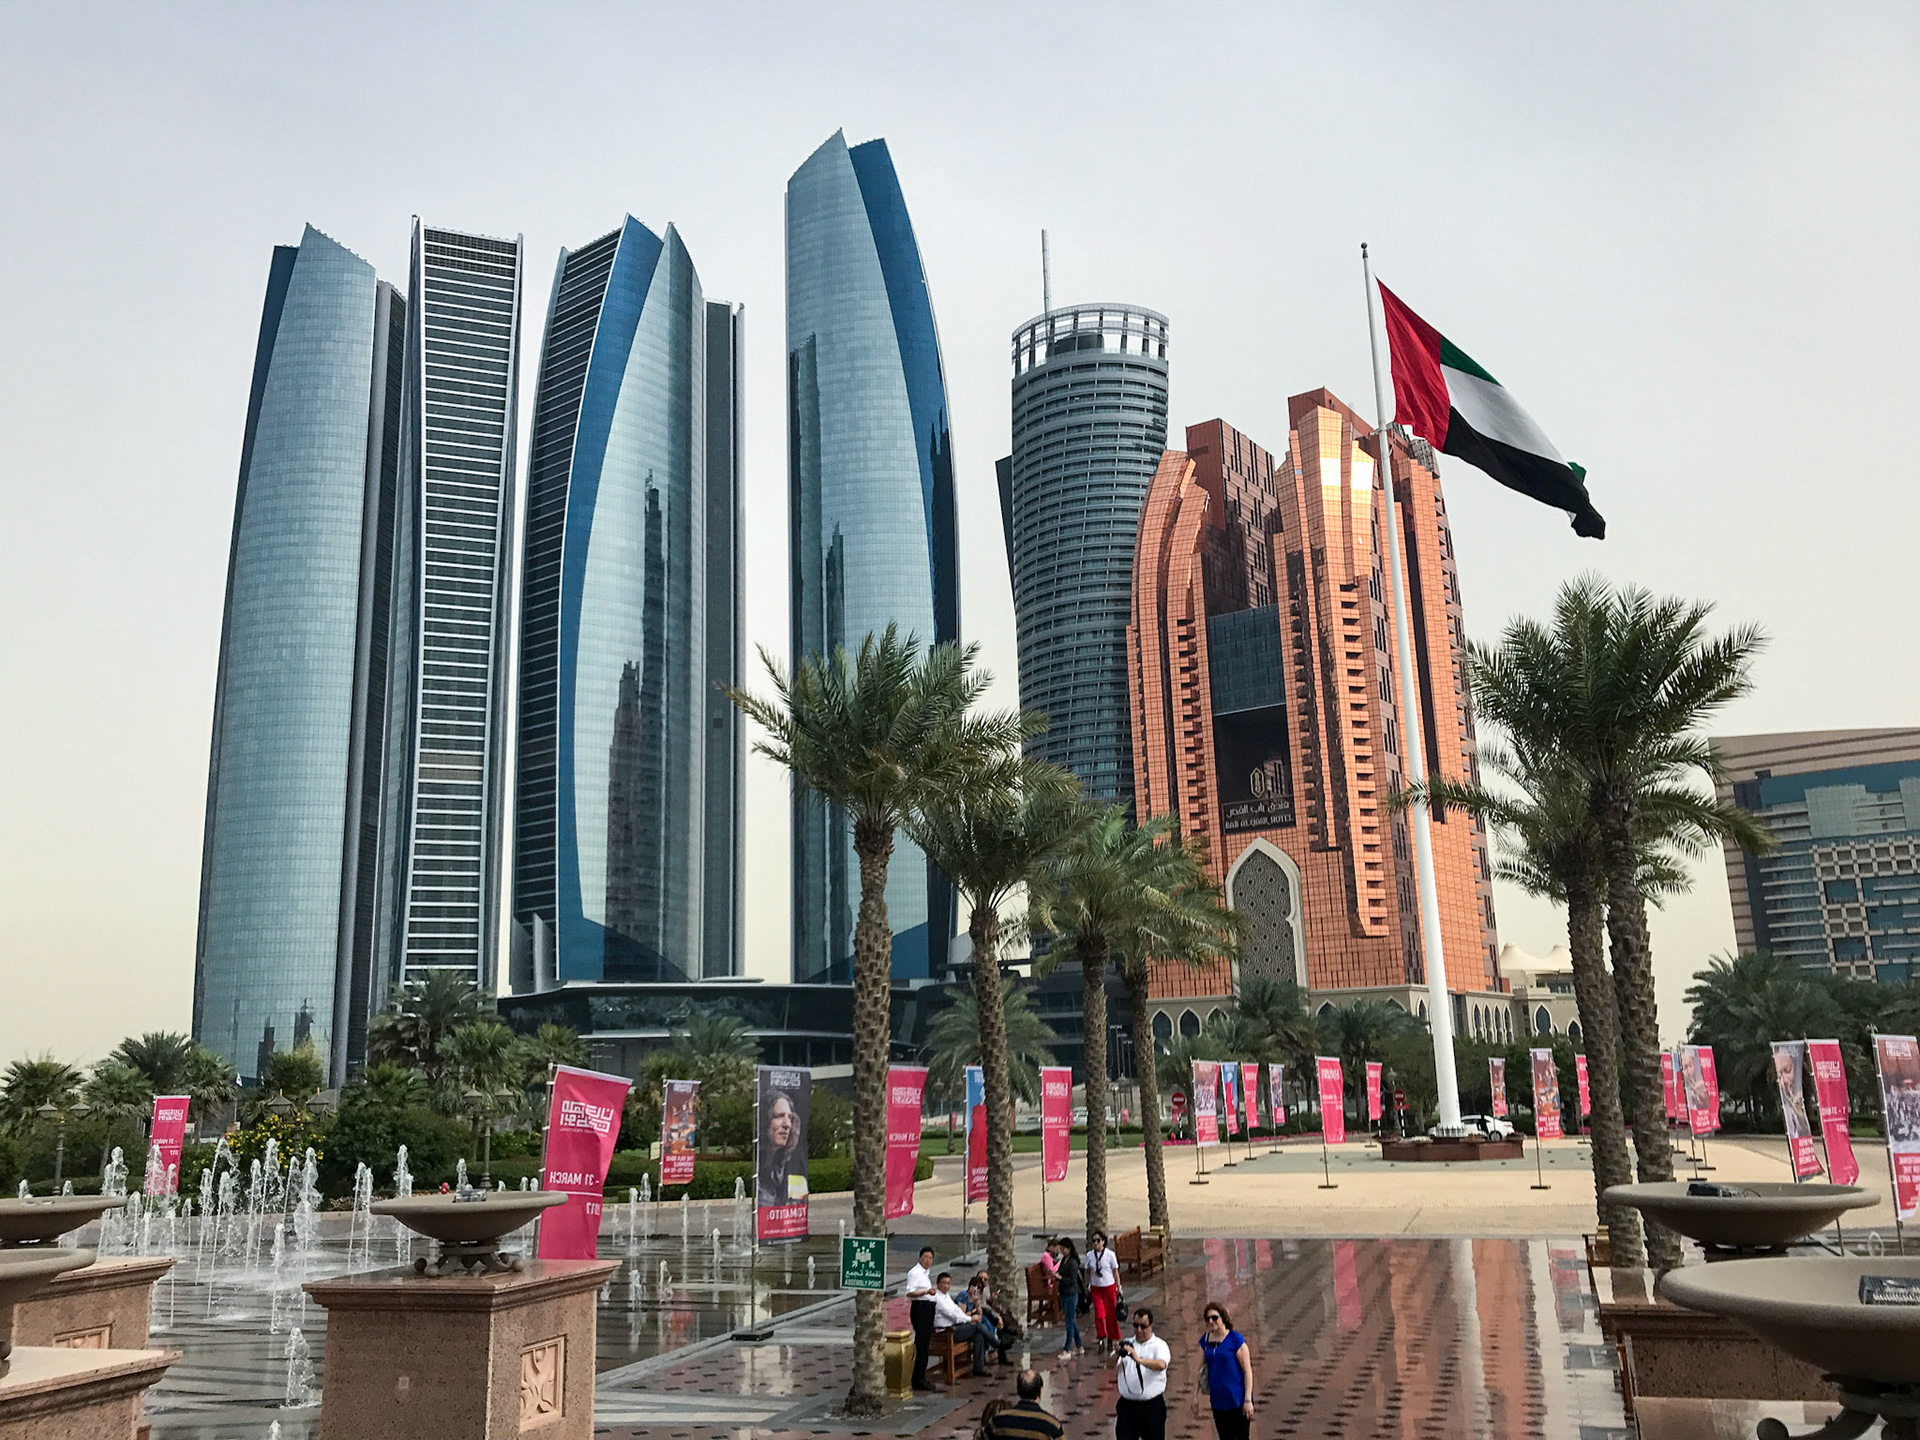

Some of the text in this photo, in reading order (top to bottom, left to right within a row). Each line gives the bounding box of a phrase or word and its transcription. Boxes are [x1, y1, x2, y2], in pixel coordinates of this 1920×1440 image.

[1226, 800, 1289, 818] فندق باب القصر
[1225, 820, 1239, 829] BAB
[1240, 819, 1250, 828] AL
[1270, 814, 1293, 824] HOTEL
[867, 1280, 882, 1288] POINT
